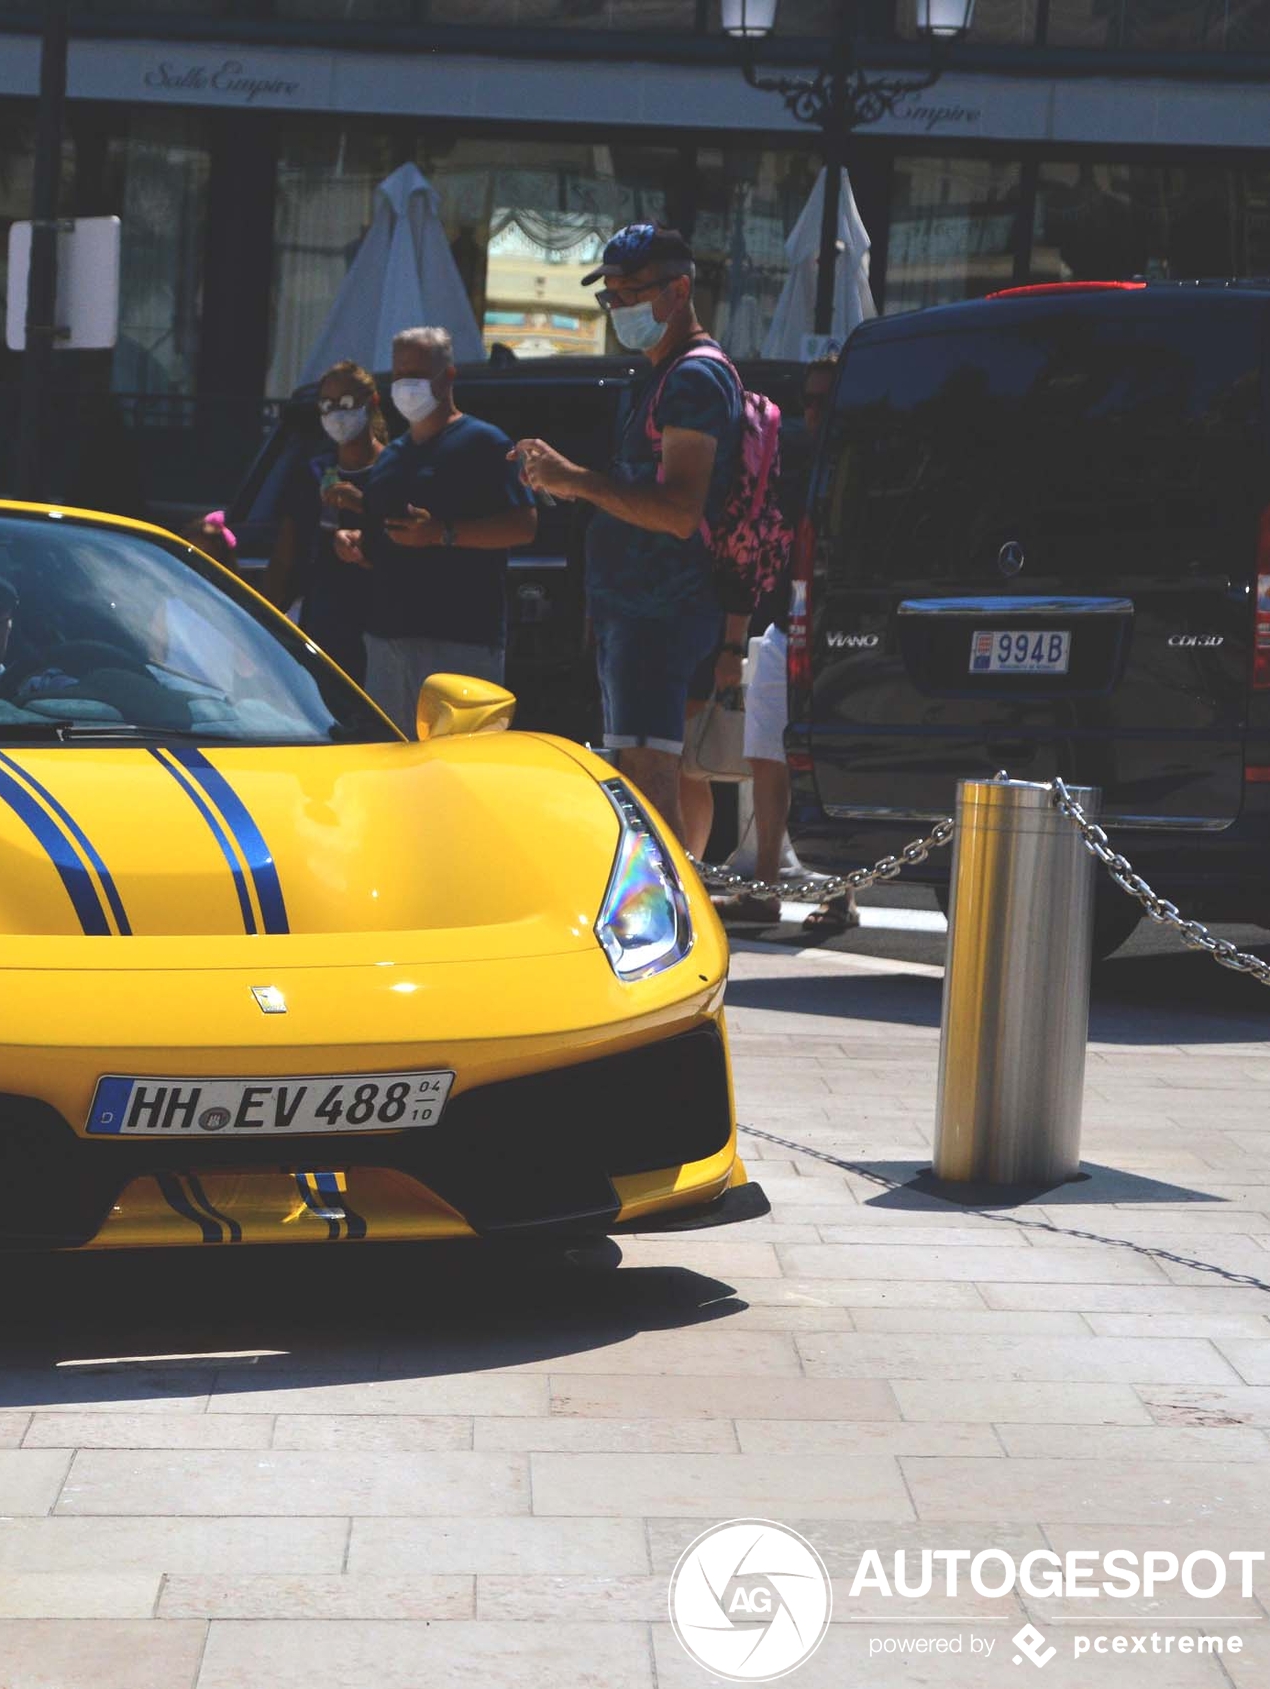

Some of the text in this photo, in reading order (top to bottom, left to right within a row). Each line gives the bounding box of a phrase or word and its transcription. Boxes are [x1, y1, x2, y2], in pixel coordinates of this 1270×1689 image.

[143, 60, 300, 102] Salle Empire
[826, 631, 879, 647] VIANO
[998, 634, 1063, 663] 994B
[419, 1080, 441, 1093] 04
[127, 1081, 411, 1128] HH EV 488
[411, 1108, 433, 1121] 10
